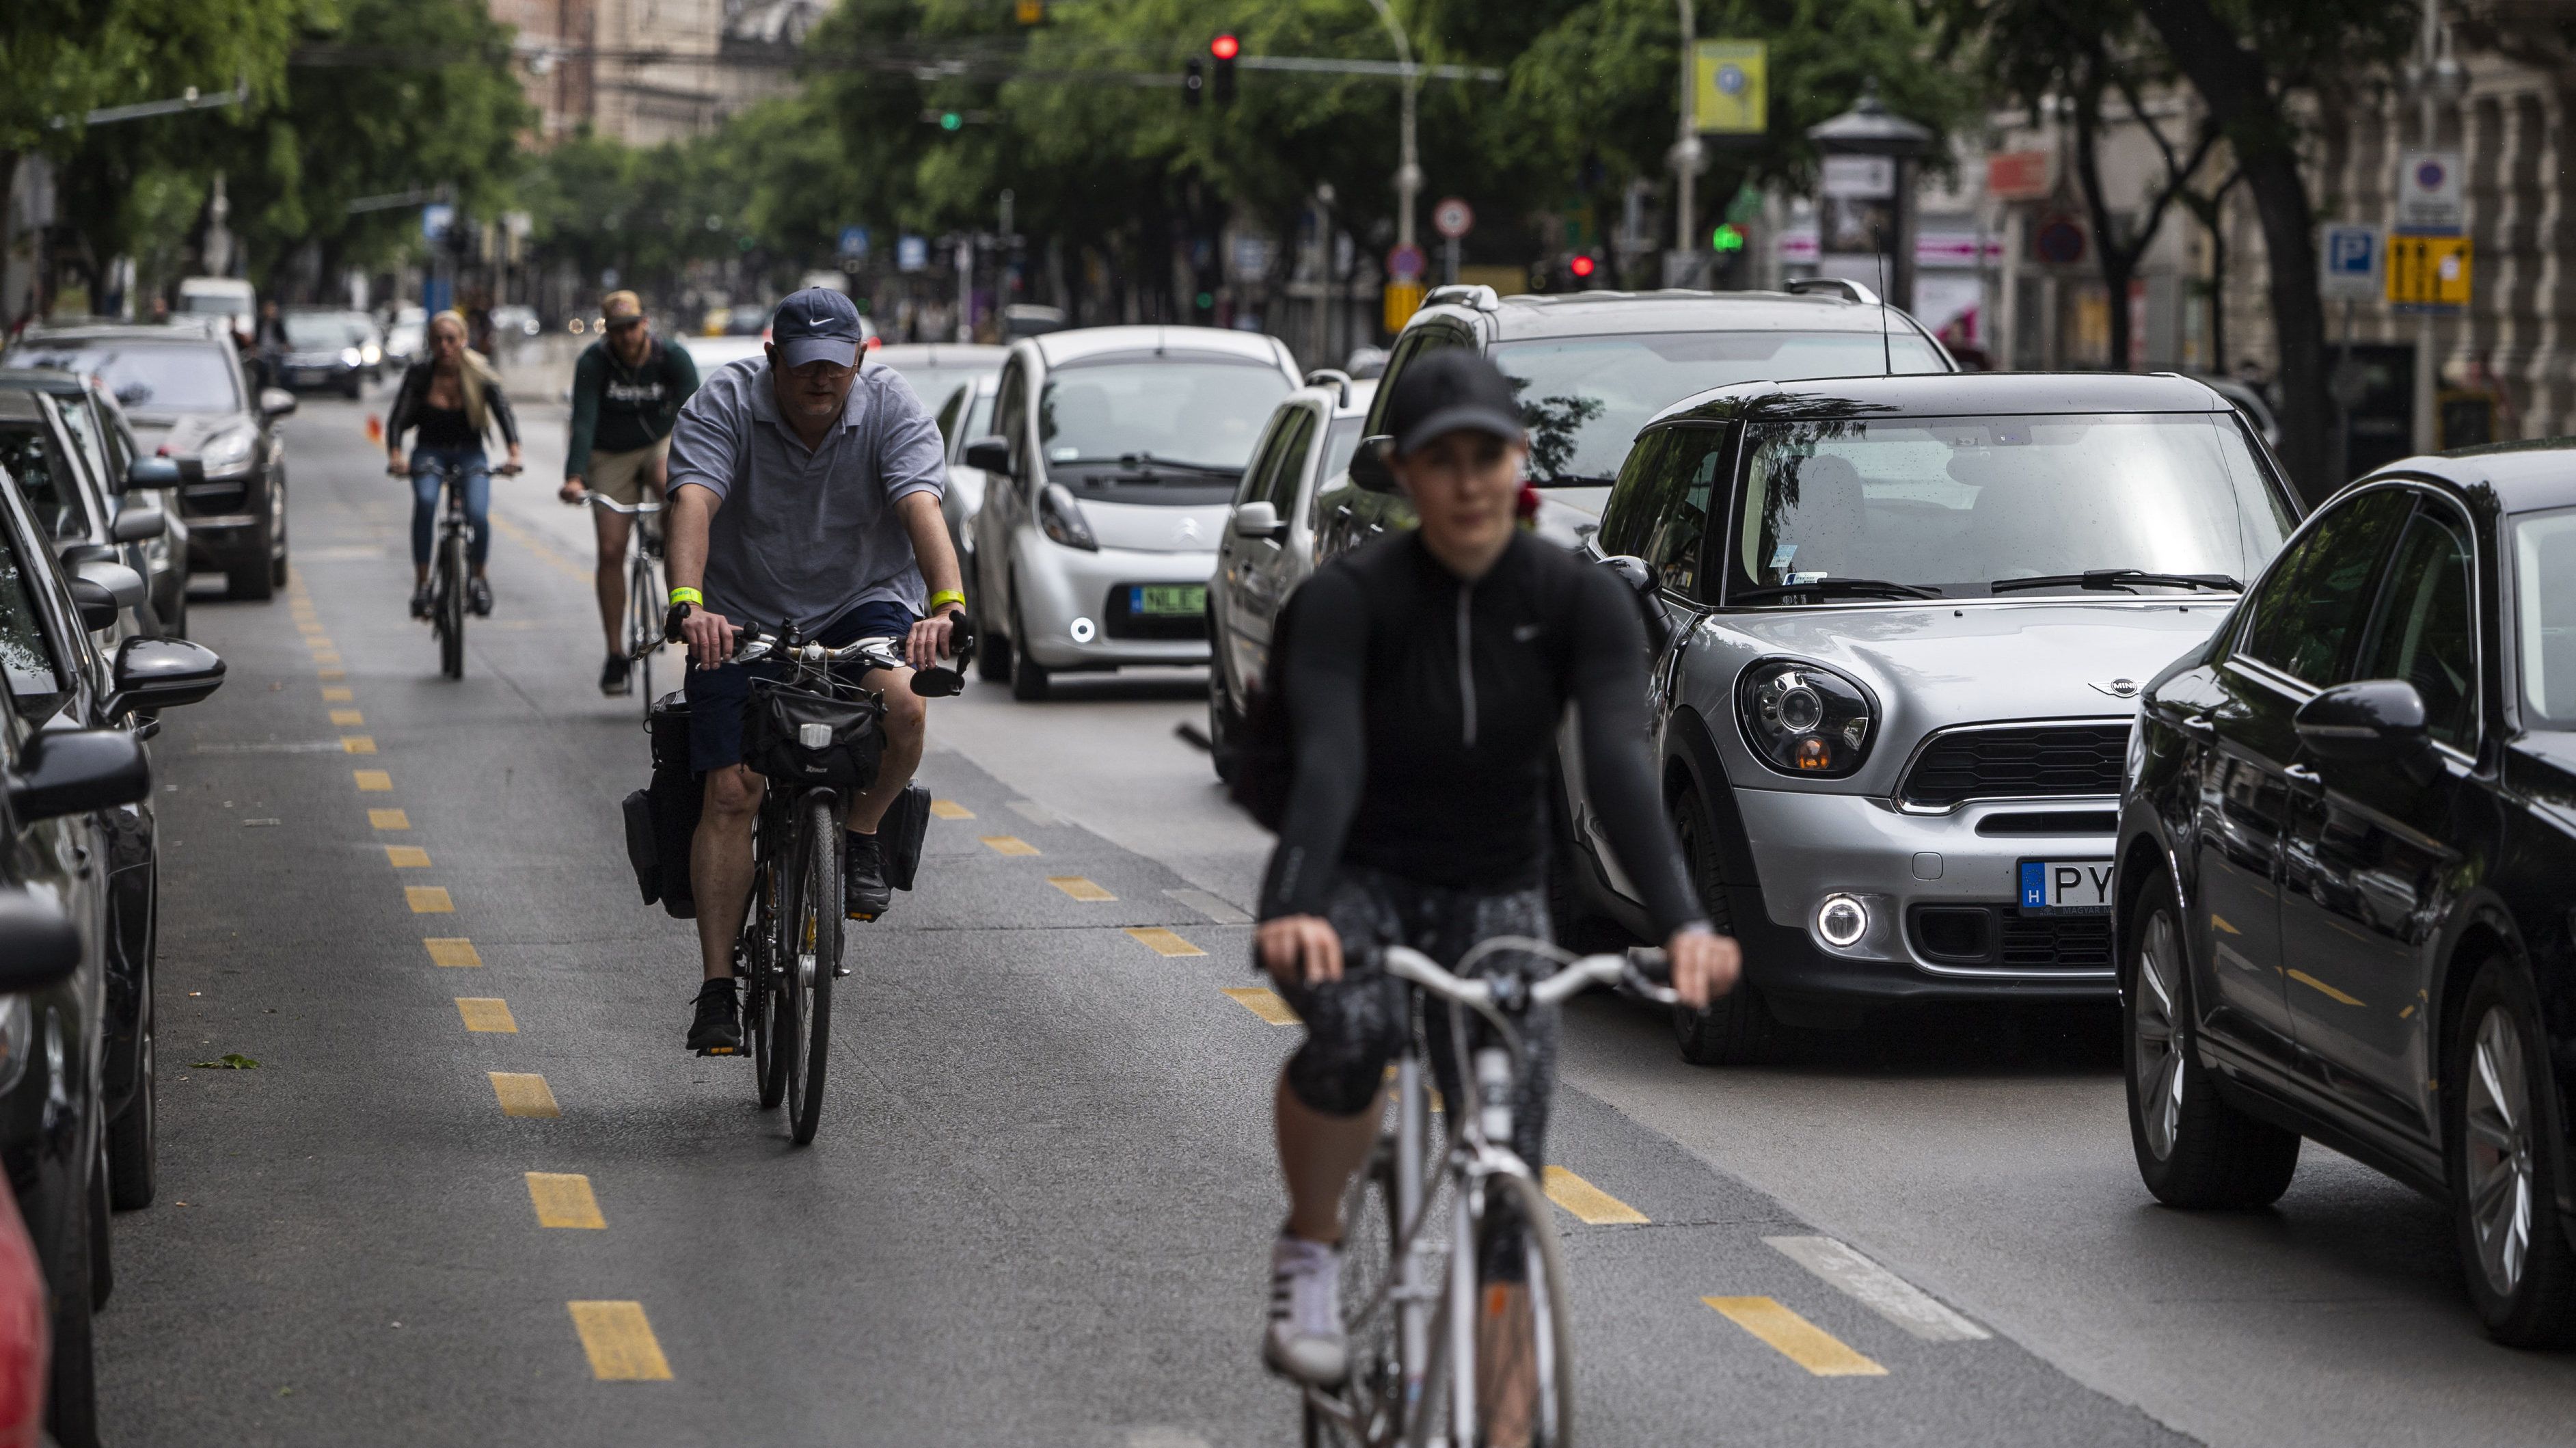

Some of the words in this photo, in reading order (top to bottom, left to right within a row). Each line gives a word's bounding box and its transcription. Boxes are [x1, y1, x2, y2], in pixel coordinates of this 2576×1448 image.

[2338, 236, 2367, 270] P
[841, 645, 858, 654] ZOOM
[2029, 890, 2039, 902] H
[2063, 907, 2100, 915] MAGYAR
